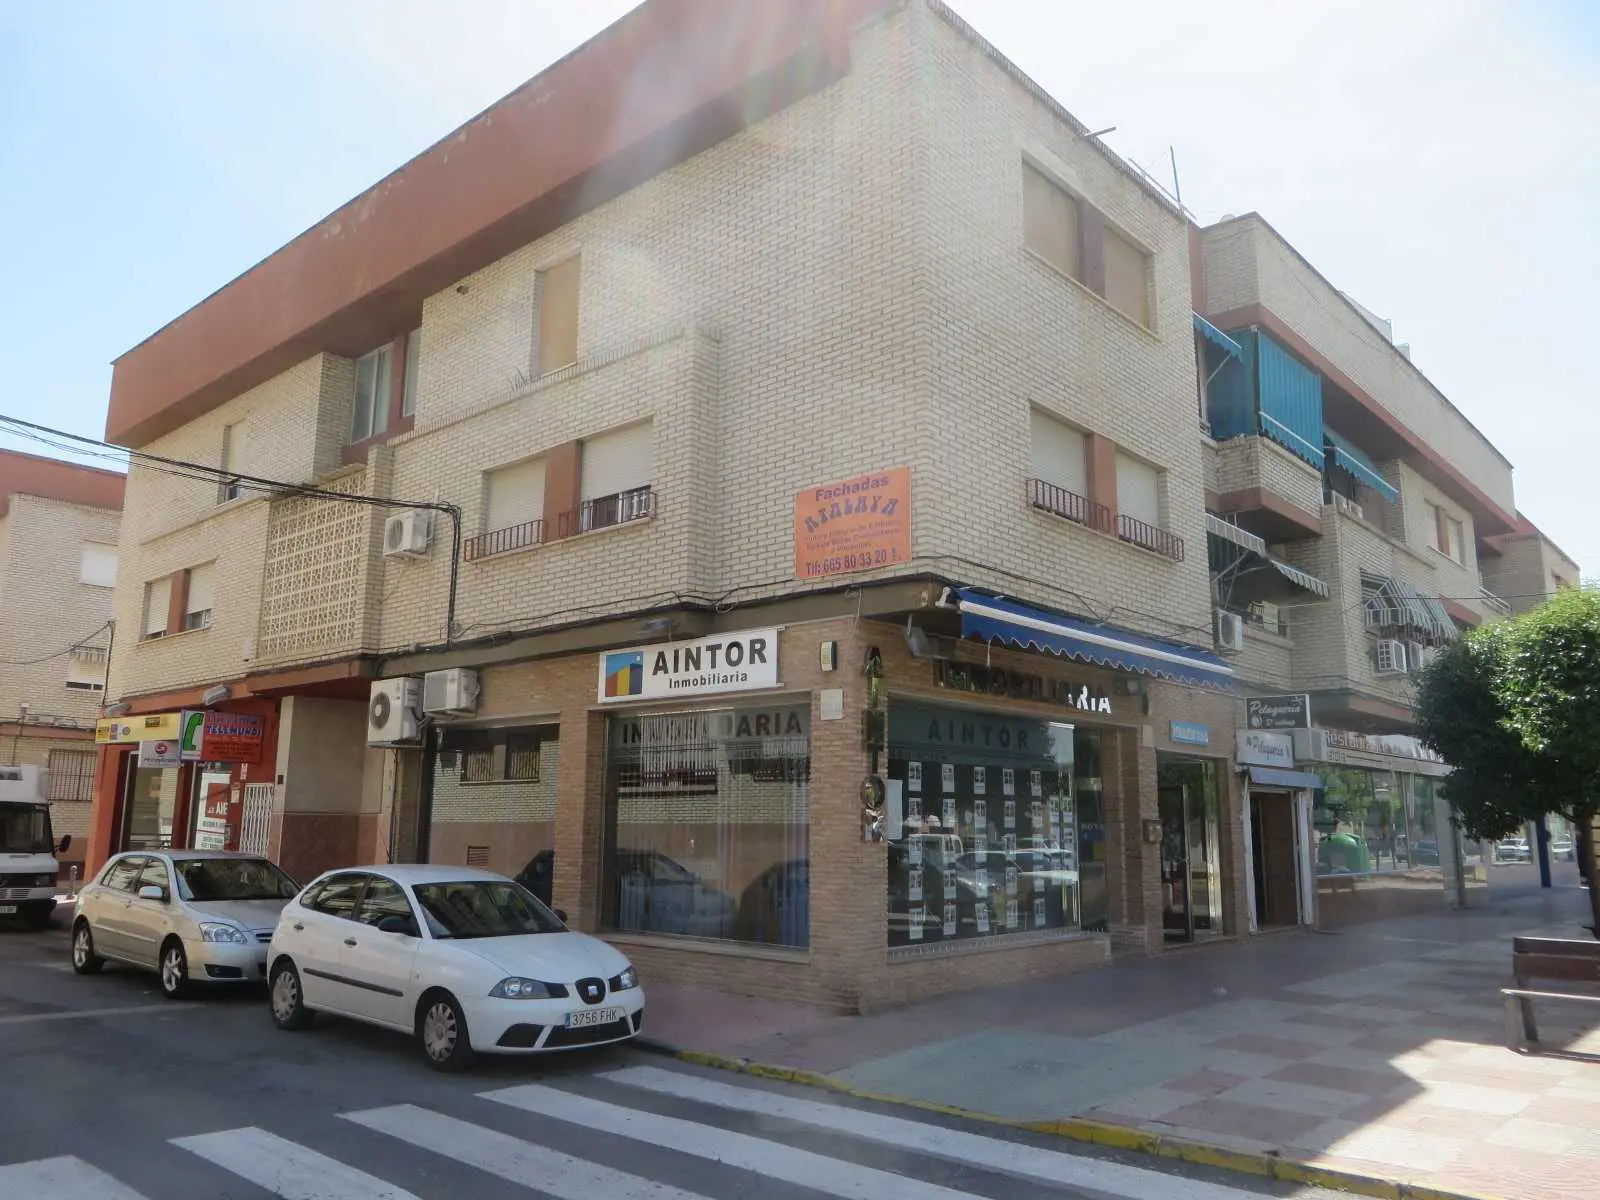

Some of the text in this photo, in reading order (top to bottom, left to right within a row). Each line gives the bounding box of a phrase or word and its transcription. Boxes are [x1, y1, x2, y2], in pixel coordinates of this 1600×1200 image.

[816, 476, 890, 501] Fachadas
[844, 554, 857, 569] 80
[860, 551, 872, 567] 33
[875, 549, 887, 564] 20
[652, 638, 768, 676] AINTOR
[669, 670, 749, 689] Inmobiliaria
[927, 717, 1029, 750] AINTOR
[572, 1009, 618, 1026] 3756 FHK
